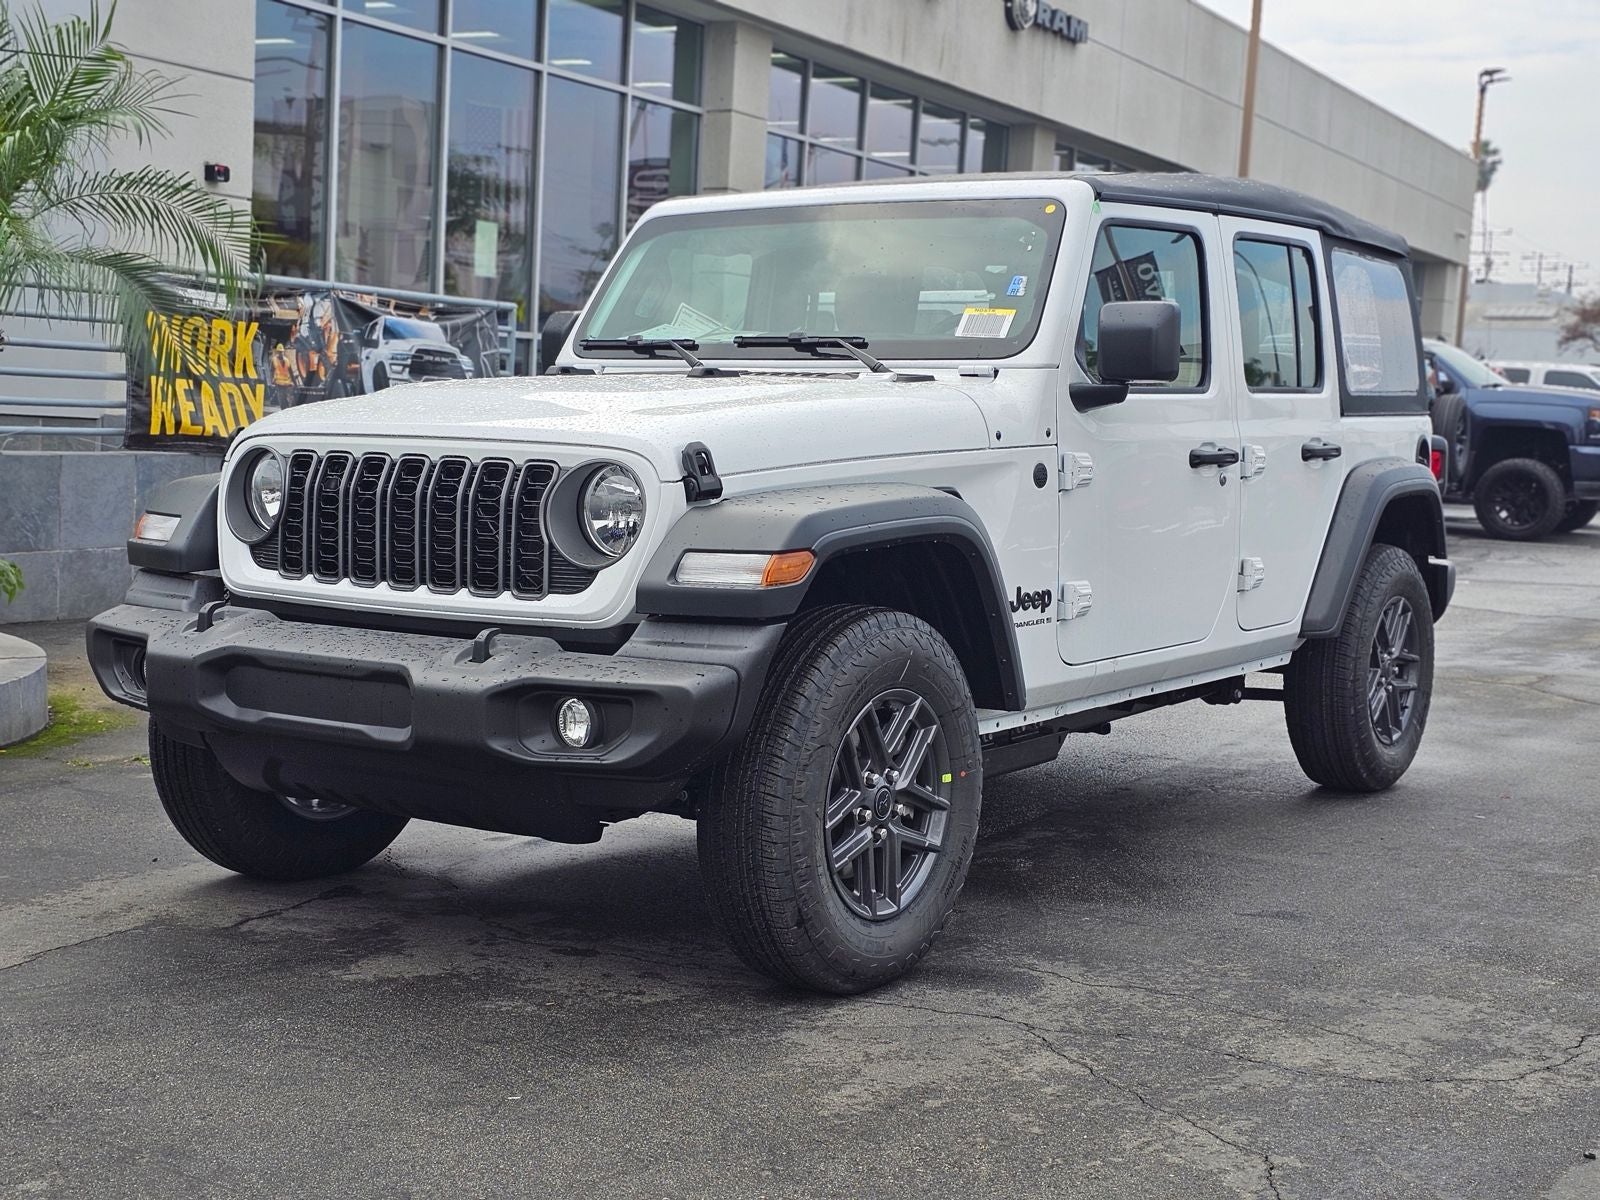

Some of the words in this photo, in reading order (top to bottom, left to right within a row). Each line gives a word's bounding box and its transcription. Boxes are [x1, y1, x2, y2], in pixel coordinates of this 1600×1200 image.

[1036, 1, 1089, 44] RAM
[1008, 585, 1052, 614] Jeep
[1014, 618, 1045, 628] RANGLER
